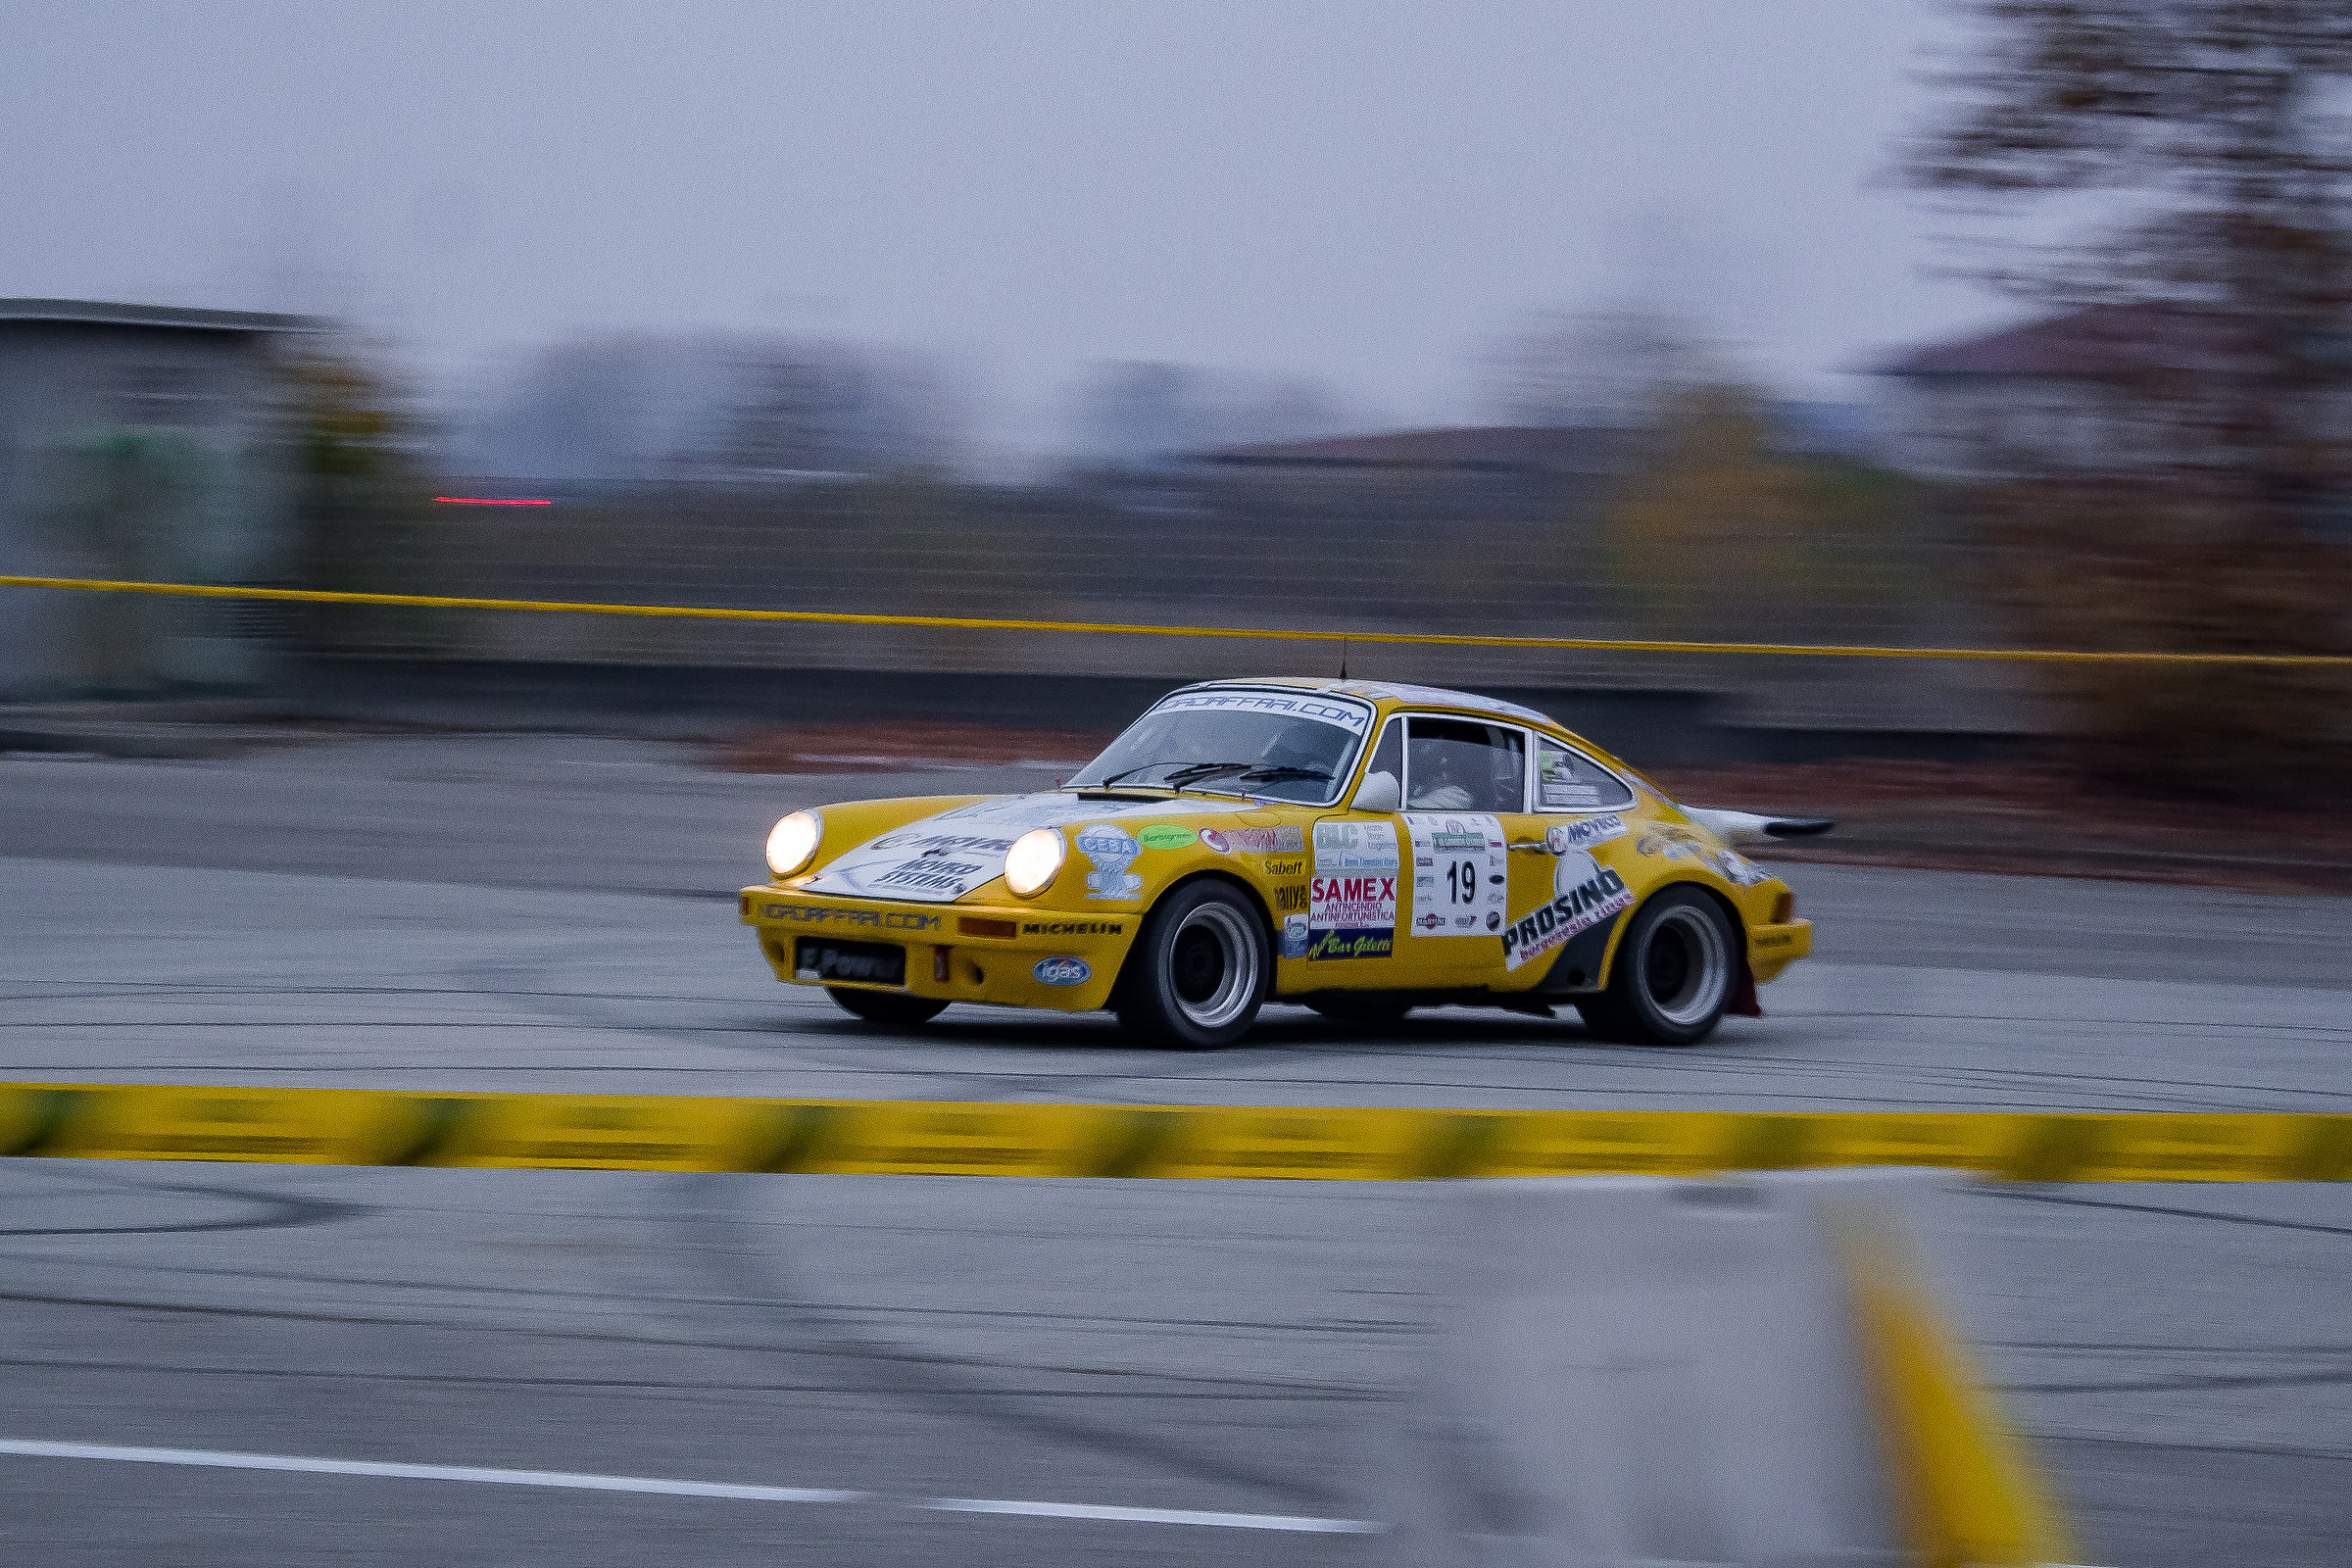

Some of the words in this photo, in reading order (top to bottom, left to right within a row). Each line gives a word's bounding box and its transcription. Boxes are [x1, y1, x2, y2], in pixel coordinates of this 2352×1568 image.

[1264, 860, 1301, 874] Sabelt
[1312, 878, 1396, 902] SAMEX
[1446, 860, 1475, 905] 19
[1501, 868, 1625, 957] PROSINO
[1022, 923, 1122, 935] MICHELIN
